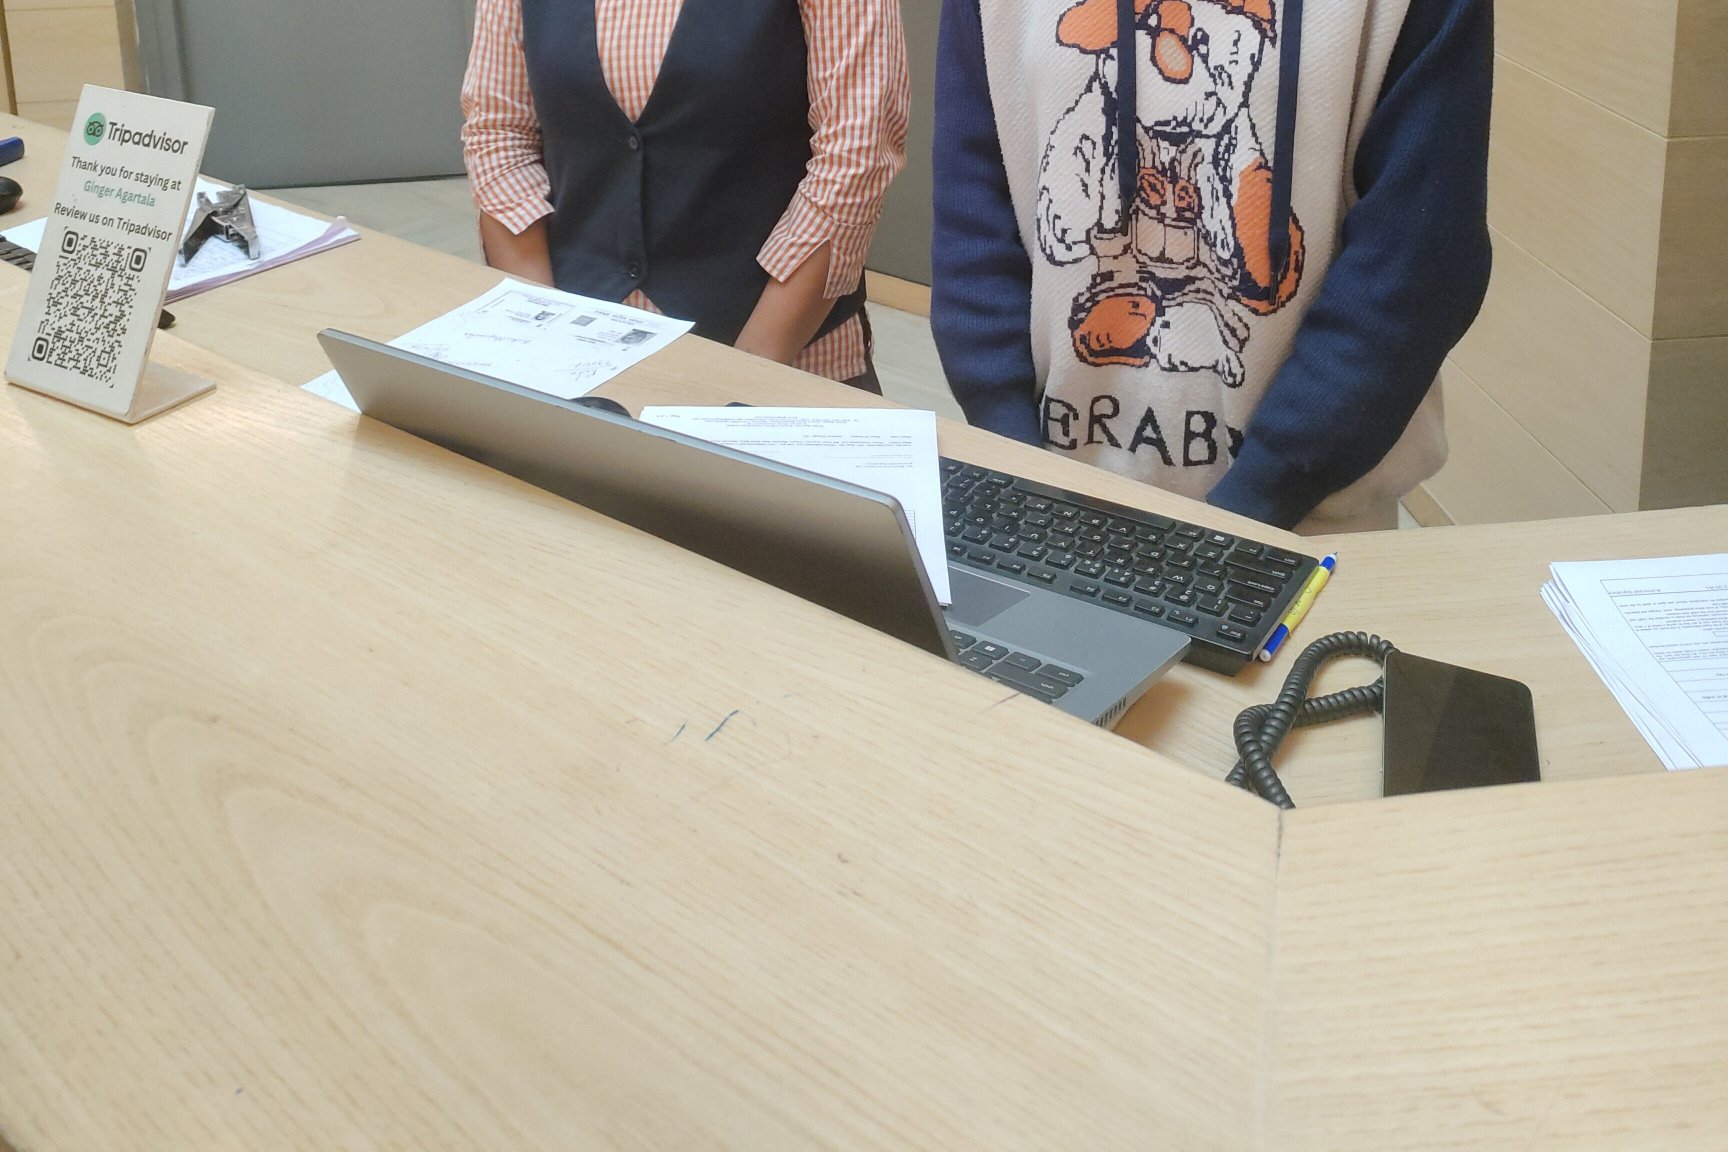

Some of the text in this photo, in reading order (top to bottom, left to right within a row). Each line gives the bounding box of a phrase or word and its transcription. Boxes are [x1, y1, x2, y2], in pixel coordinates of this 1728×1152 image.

[107, 121, 188, 154] Tripadvisor
[71, 156, 182, 191] Thank you for staying at
[83, 180, 156, 207] Ginger Agartala
[54, 202, 173, 242] Review us on Tripadvisor
